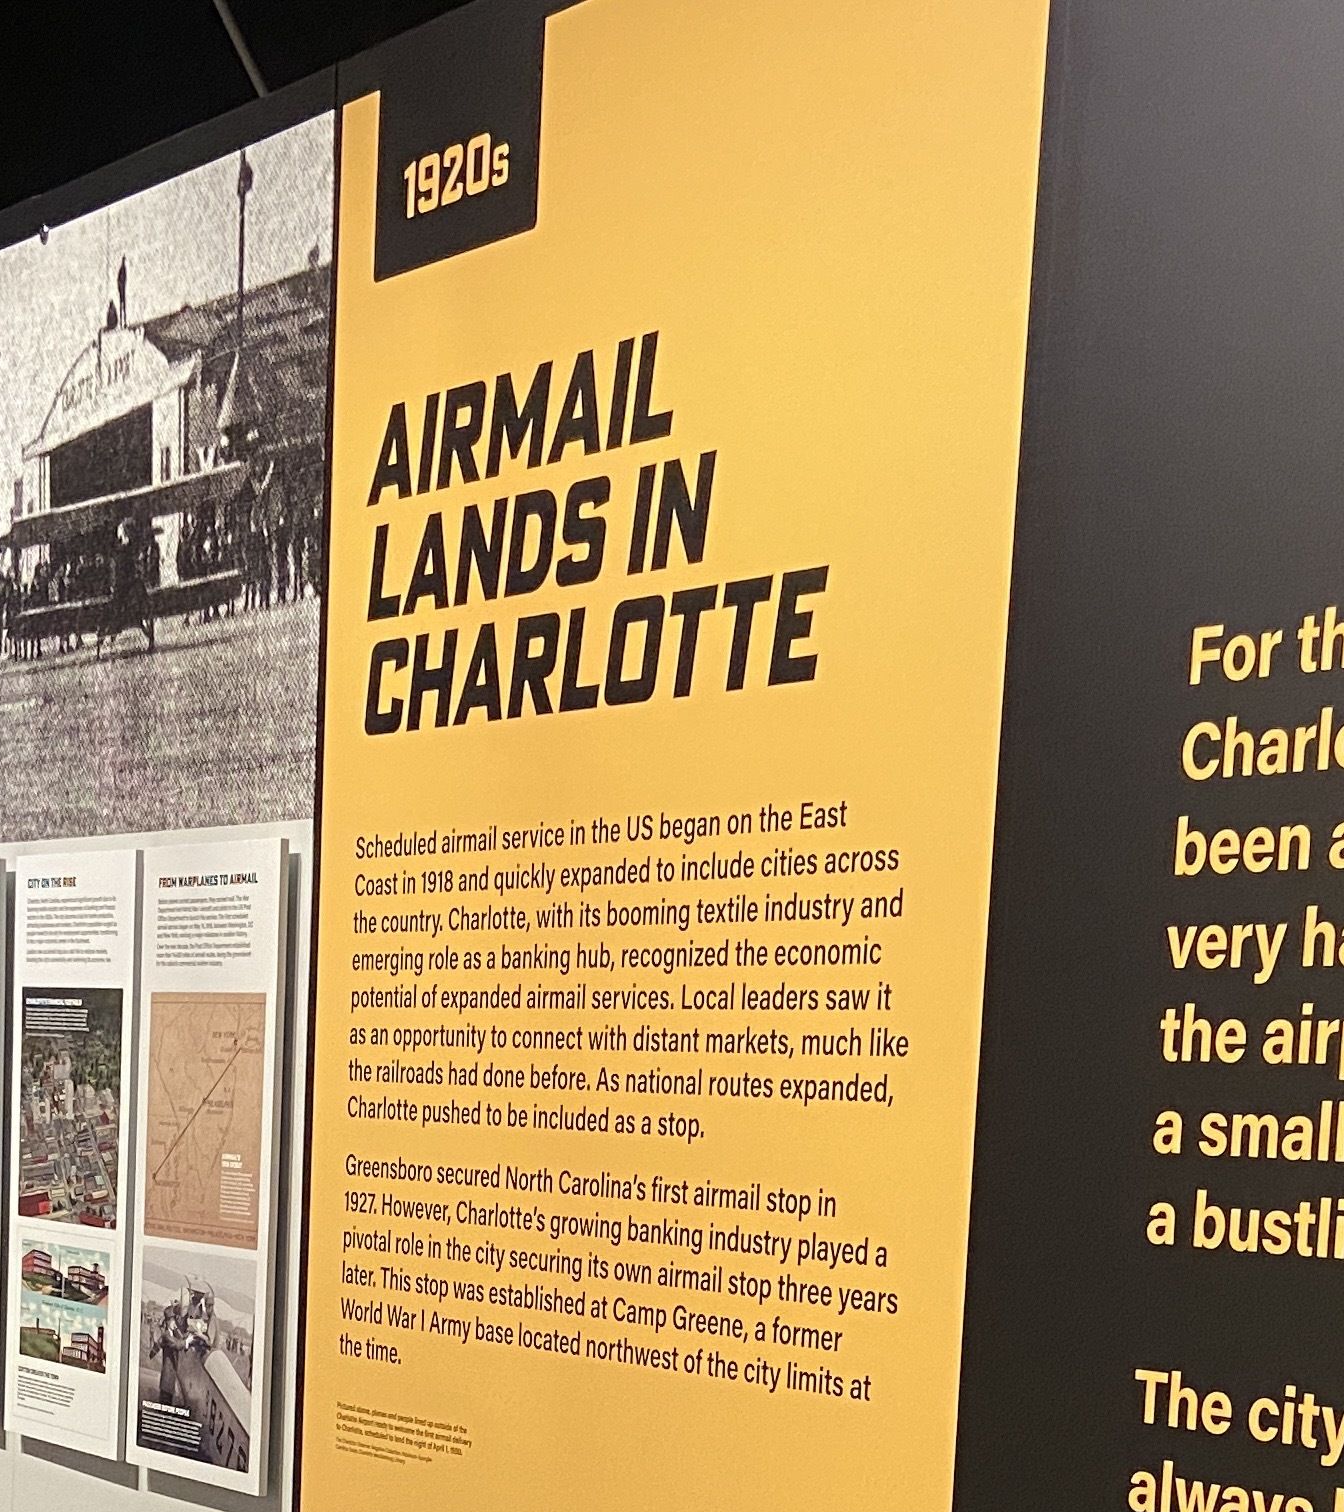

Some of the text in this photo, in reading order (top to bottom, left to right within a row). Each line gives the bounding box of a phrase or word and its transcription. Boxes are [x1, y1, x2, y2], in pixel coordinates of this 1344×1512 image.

[403, 132, 510, 219] 1920s
[366, 330, 674, 508] AIRMAIL
[366, 449, 718, 623] LANDS IN
[364, 564, 830, 736] CHARLOTTE
[1189, 623, 1283, 686] For
[355, 800, 848, 860] Scheduled airmail service in the US began on the East
[1174, 815, 1311, 876] been
[159, 872, 258, 888] FROM WARPLANES TO AIRMAIL
[353, 887, 904, 939] the country. Charlotte, with its booming textile industry and
[1166, 922, 1288, 985] very
[350, 981, 893, 1015] potential of expanded airmail services. Local leaders saw it
[1159, 1002, 1247, 1064] the
[1152, 1110, 1183, 1155] a
[345, 1153, 837, 1223] Greensboro secured North Carolina's first airmail stop in
[1146, 1202, 1176, 1246] a
[1134, 1368, 1233, 1435] The
